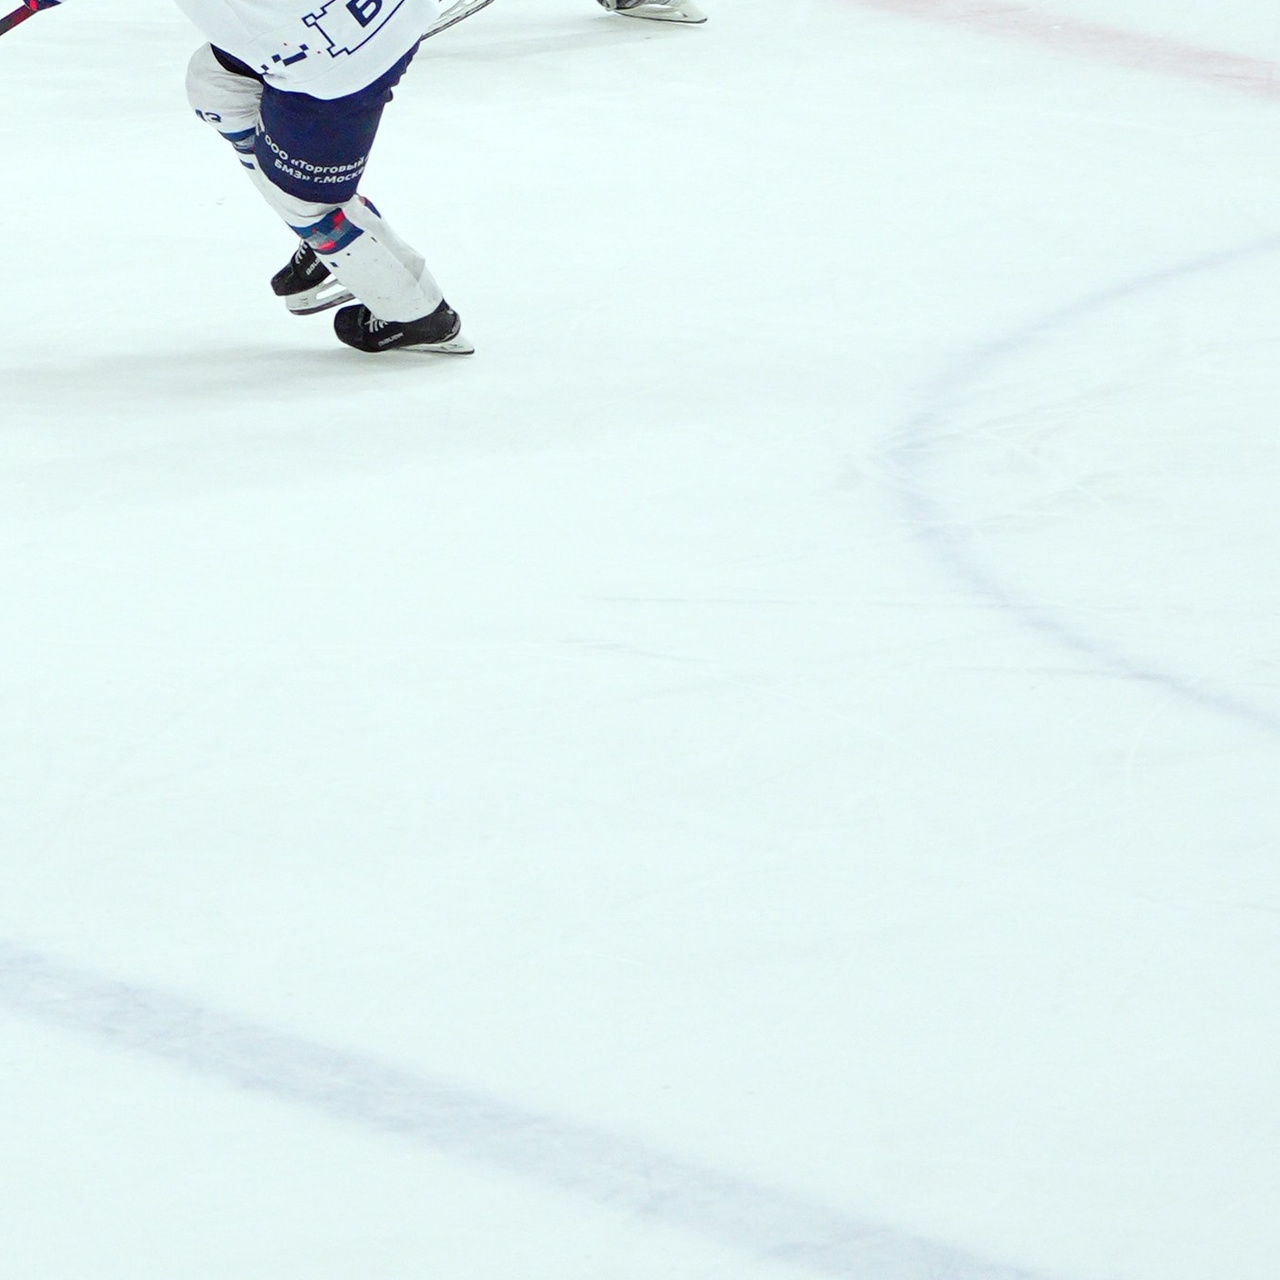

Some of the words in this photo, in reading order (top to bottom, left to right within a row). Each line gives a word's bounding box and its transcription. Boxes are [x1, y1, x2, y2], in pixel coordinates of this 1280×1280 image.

[265, 135, 289, 160] ООО
[274, 158, 310, 181] БМЗ»
[314, 166, 365, 184] г.Моск
